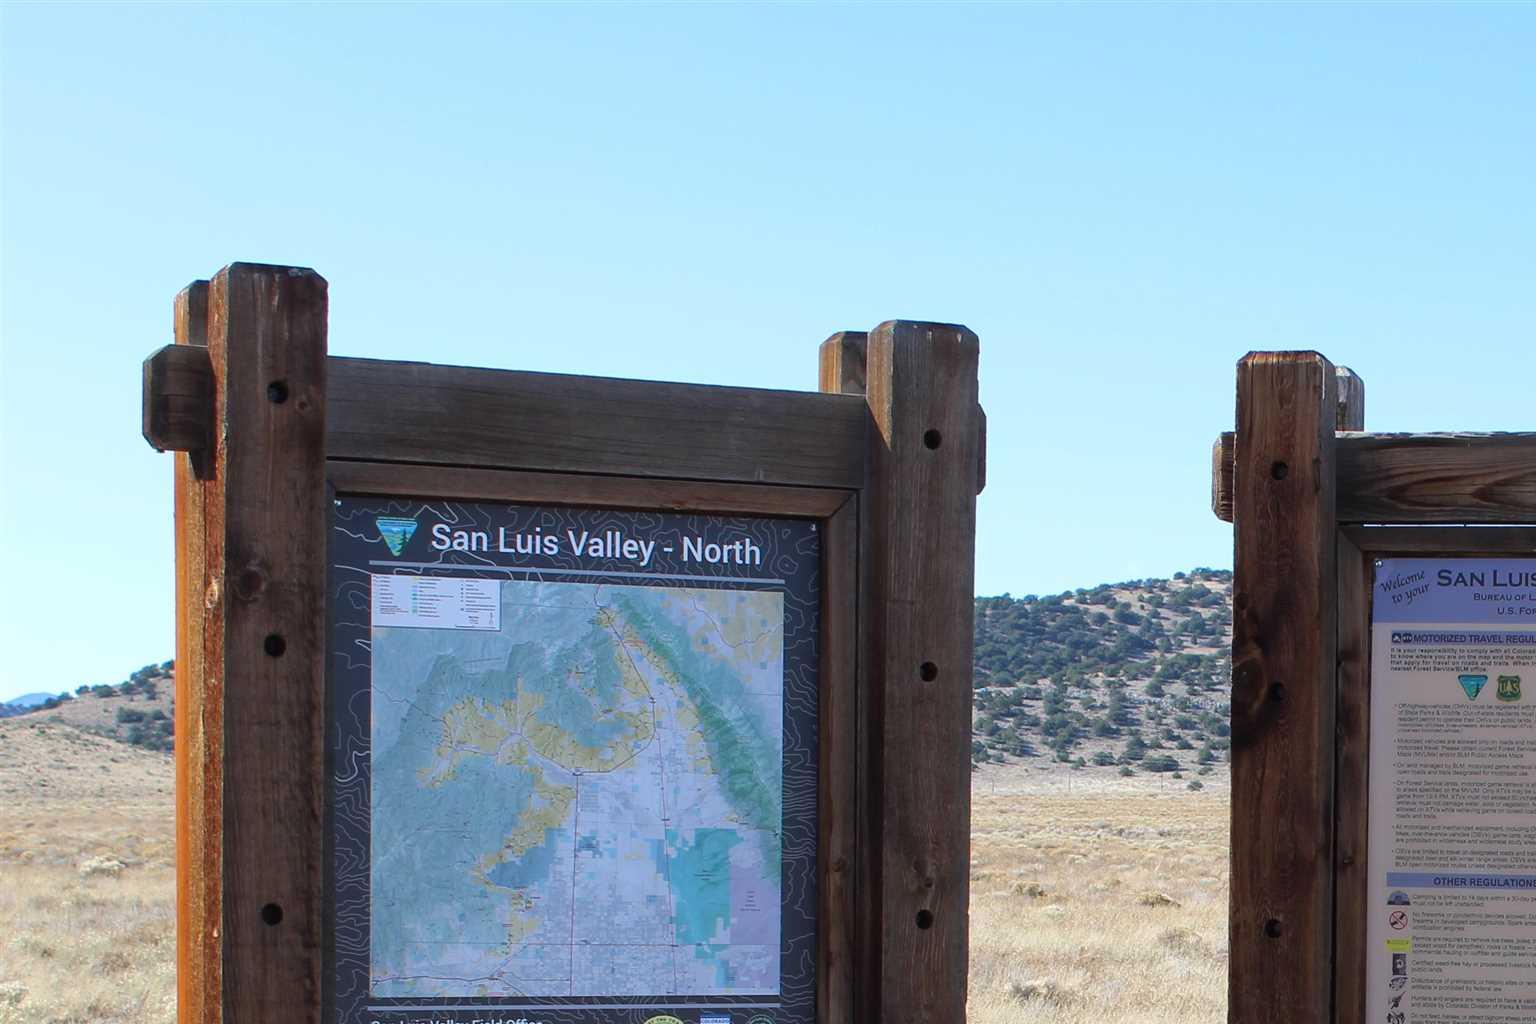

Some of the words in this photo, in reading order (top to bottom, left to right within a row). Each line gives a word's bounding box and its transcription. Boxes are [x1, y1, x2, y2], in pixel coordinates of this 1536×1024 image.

[432, 522, 488, 552] San
[499, 526, 559, 556] Luis
[567, 530, 655, 567] Valley
[681, 536, 761, 565] North
[1379, 571, 1425, 593] Welcome
[1437, 568, 1485, 587] SAN
[1391, 593, 1401, 605] to
[1406, 582, 1430, 605] your
[1473, 593, 1512, 602] BUREAU
[1497, 607, 1517, 616] U.S.
[1413, 634, 1466, 643] MOTORIZED
[1469, 634, 1503, 643] TRAVEL
[1433, 876, 1467, 887] OTHER
